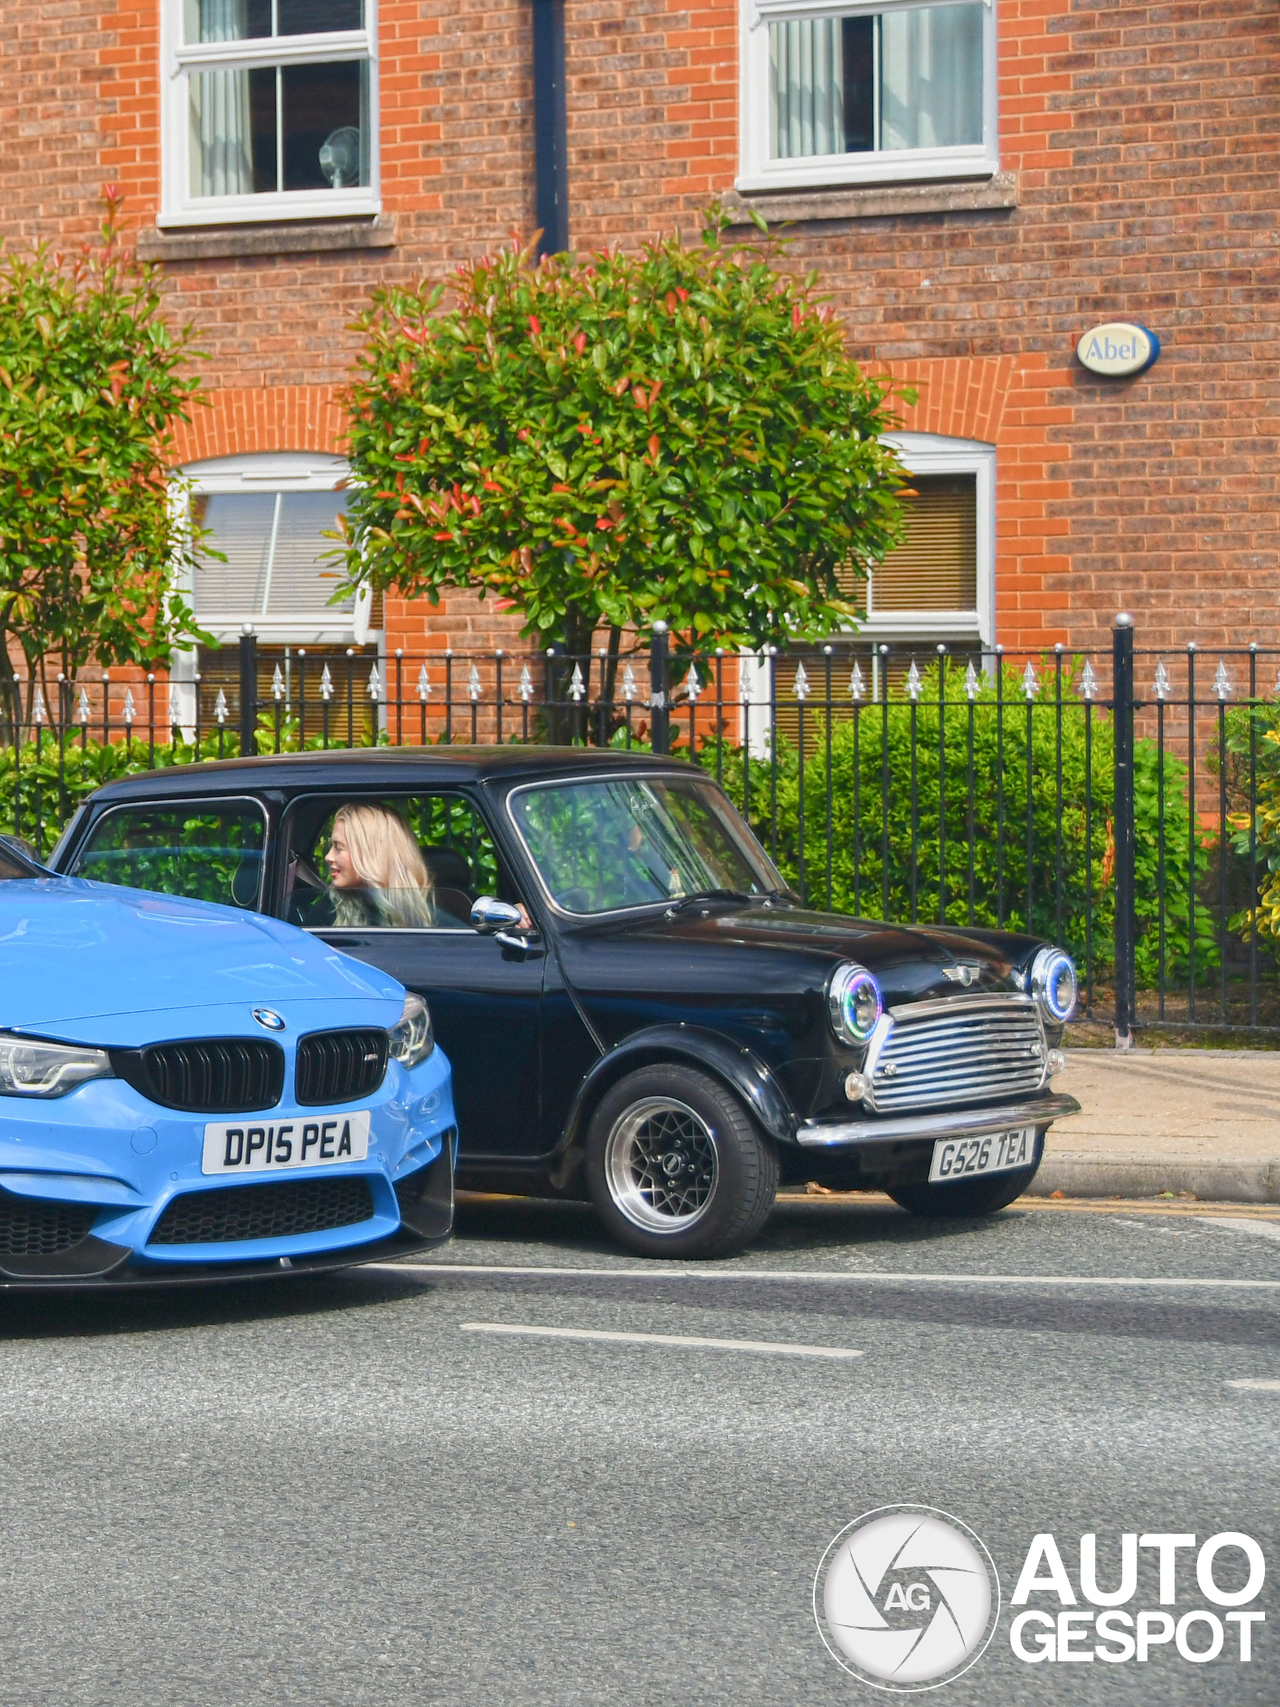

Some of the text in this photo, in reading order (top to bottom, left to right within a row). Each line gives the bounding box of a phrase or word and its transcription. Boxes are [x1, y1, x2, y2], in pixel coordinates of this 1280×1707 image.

[1085, 336, 1138, 361] Abel
[223, 1120, 351, 1166] DP15 PEA
[940, 1130, 1027, 1176] G526 TEA
